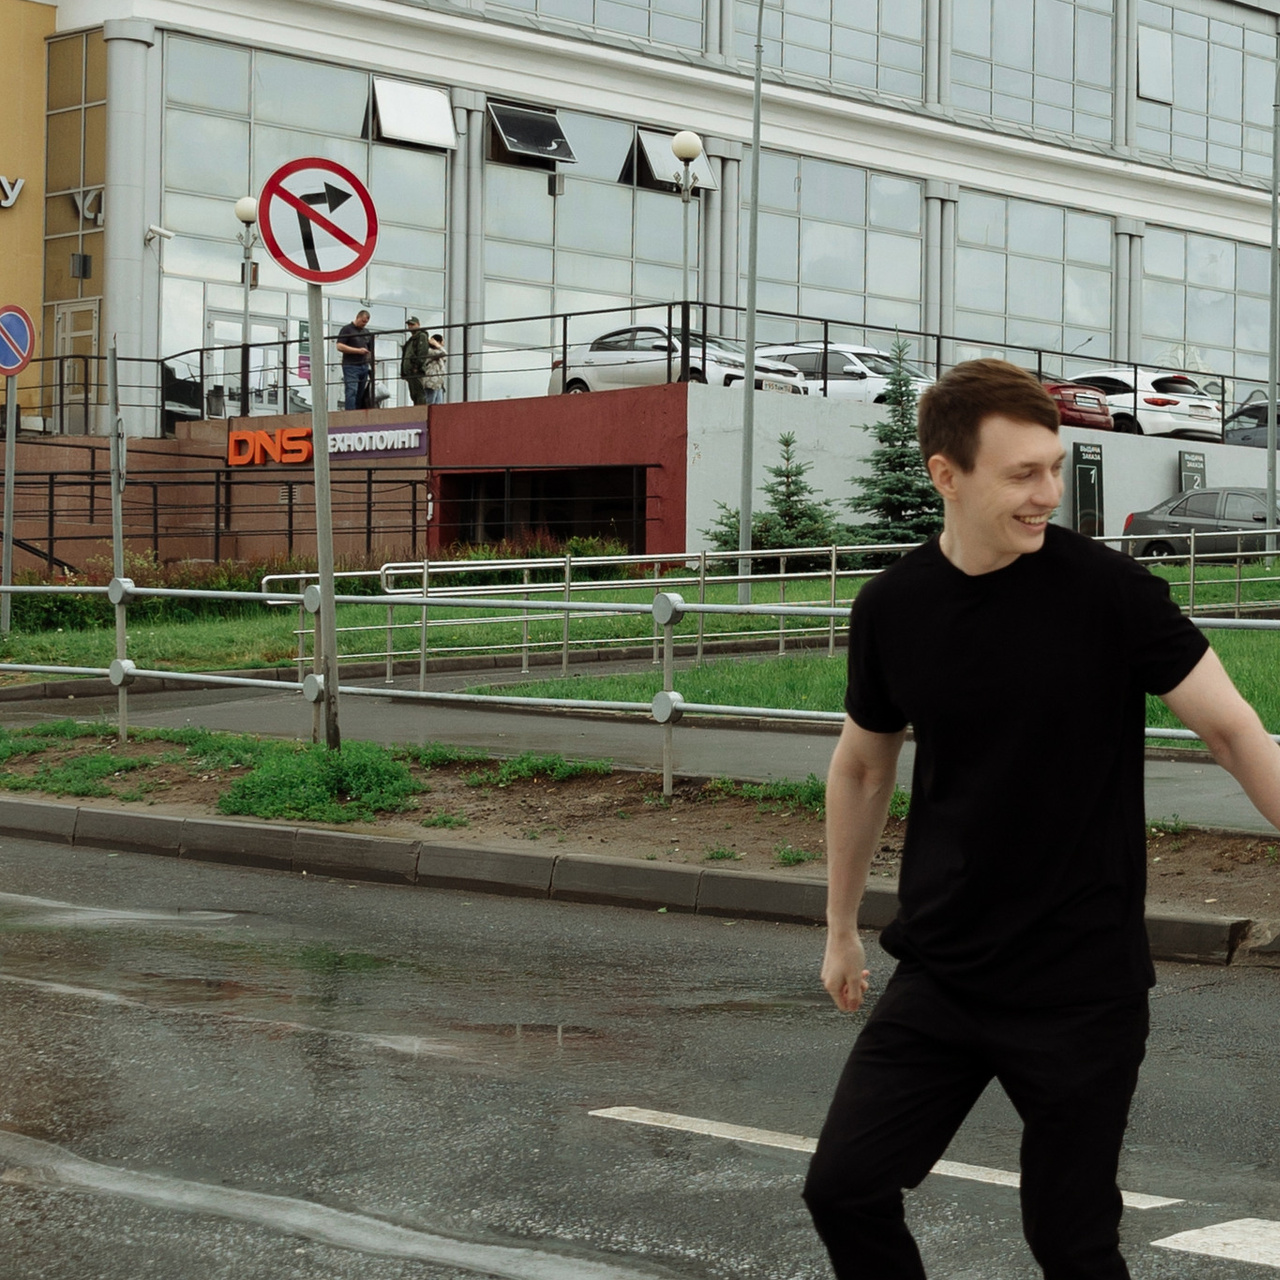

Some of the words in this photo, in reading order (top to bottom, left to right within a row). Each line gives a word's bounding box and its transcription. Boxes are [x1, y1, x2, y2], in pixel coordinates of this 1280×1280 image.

[228, 427, 312, 465] DNS
[328, 429, 422, 453] ЕХНОПОИНТ
[1090, 468, 1096, 484] 1
[1193, 475, 1201, 489] 2
